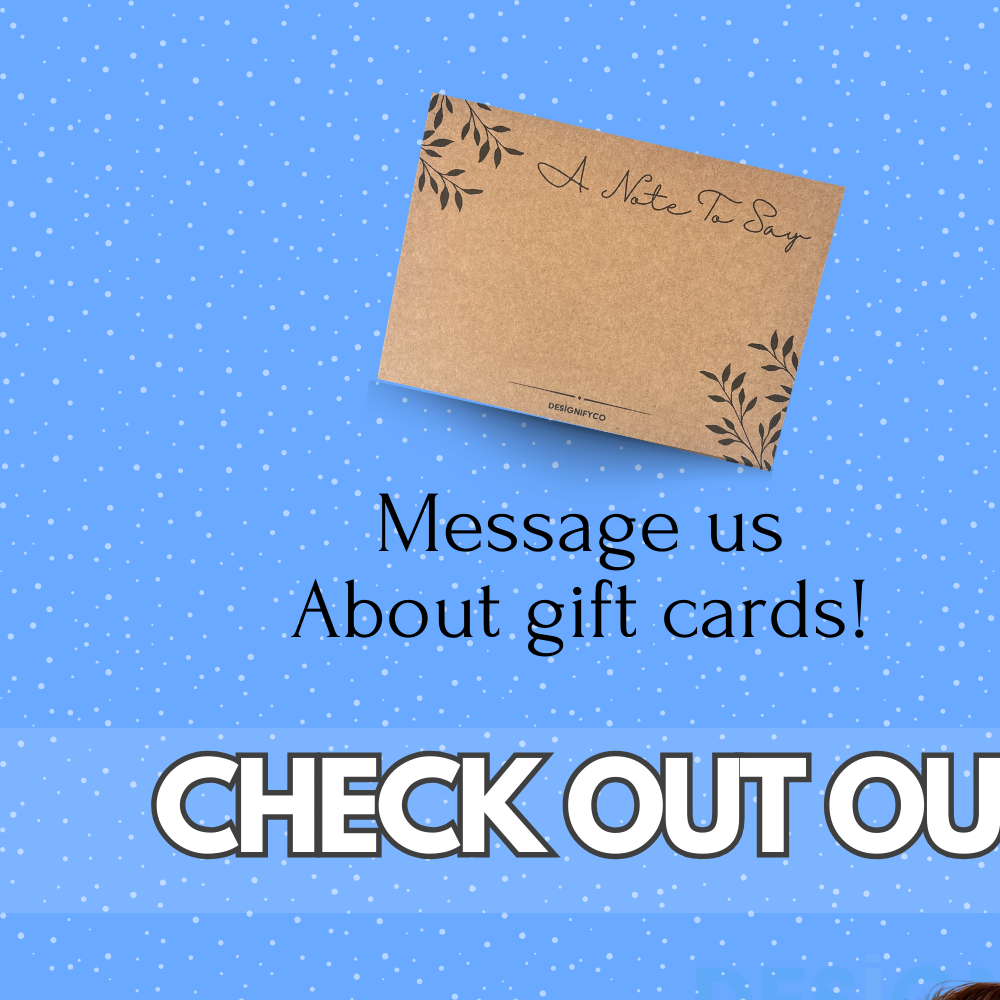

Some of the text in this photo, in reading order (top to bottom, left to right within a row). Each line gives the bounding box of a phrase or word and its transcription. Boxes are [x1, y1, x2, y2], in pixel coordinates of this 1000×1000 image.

[537, 156, 812, 253] A Note To Say
